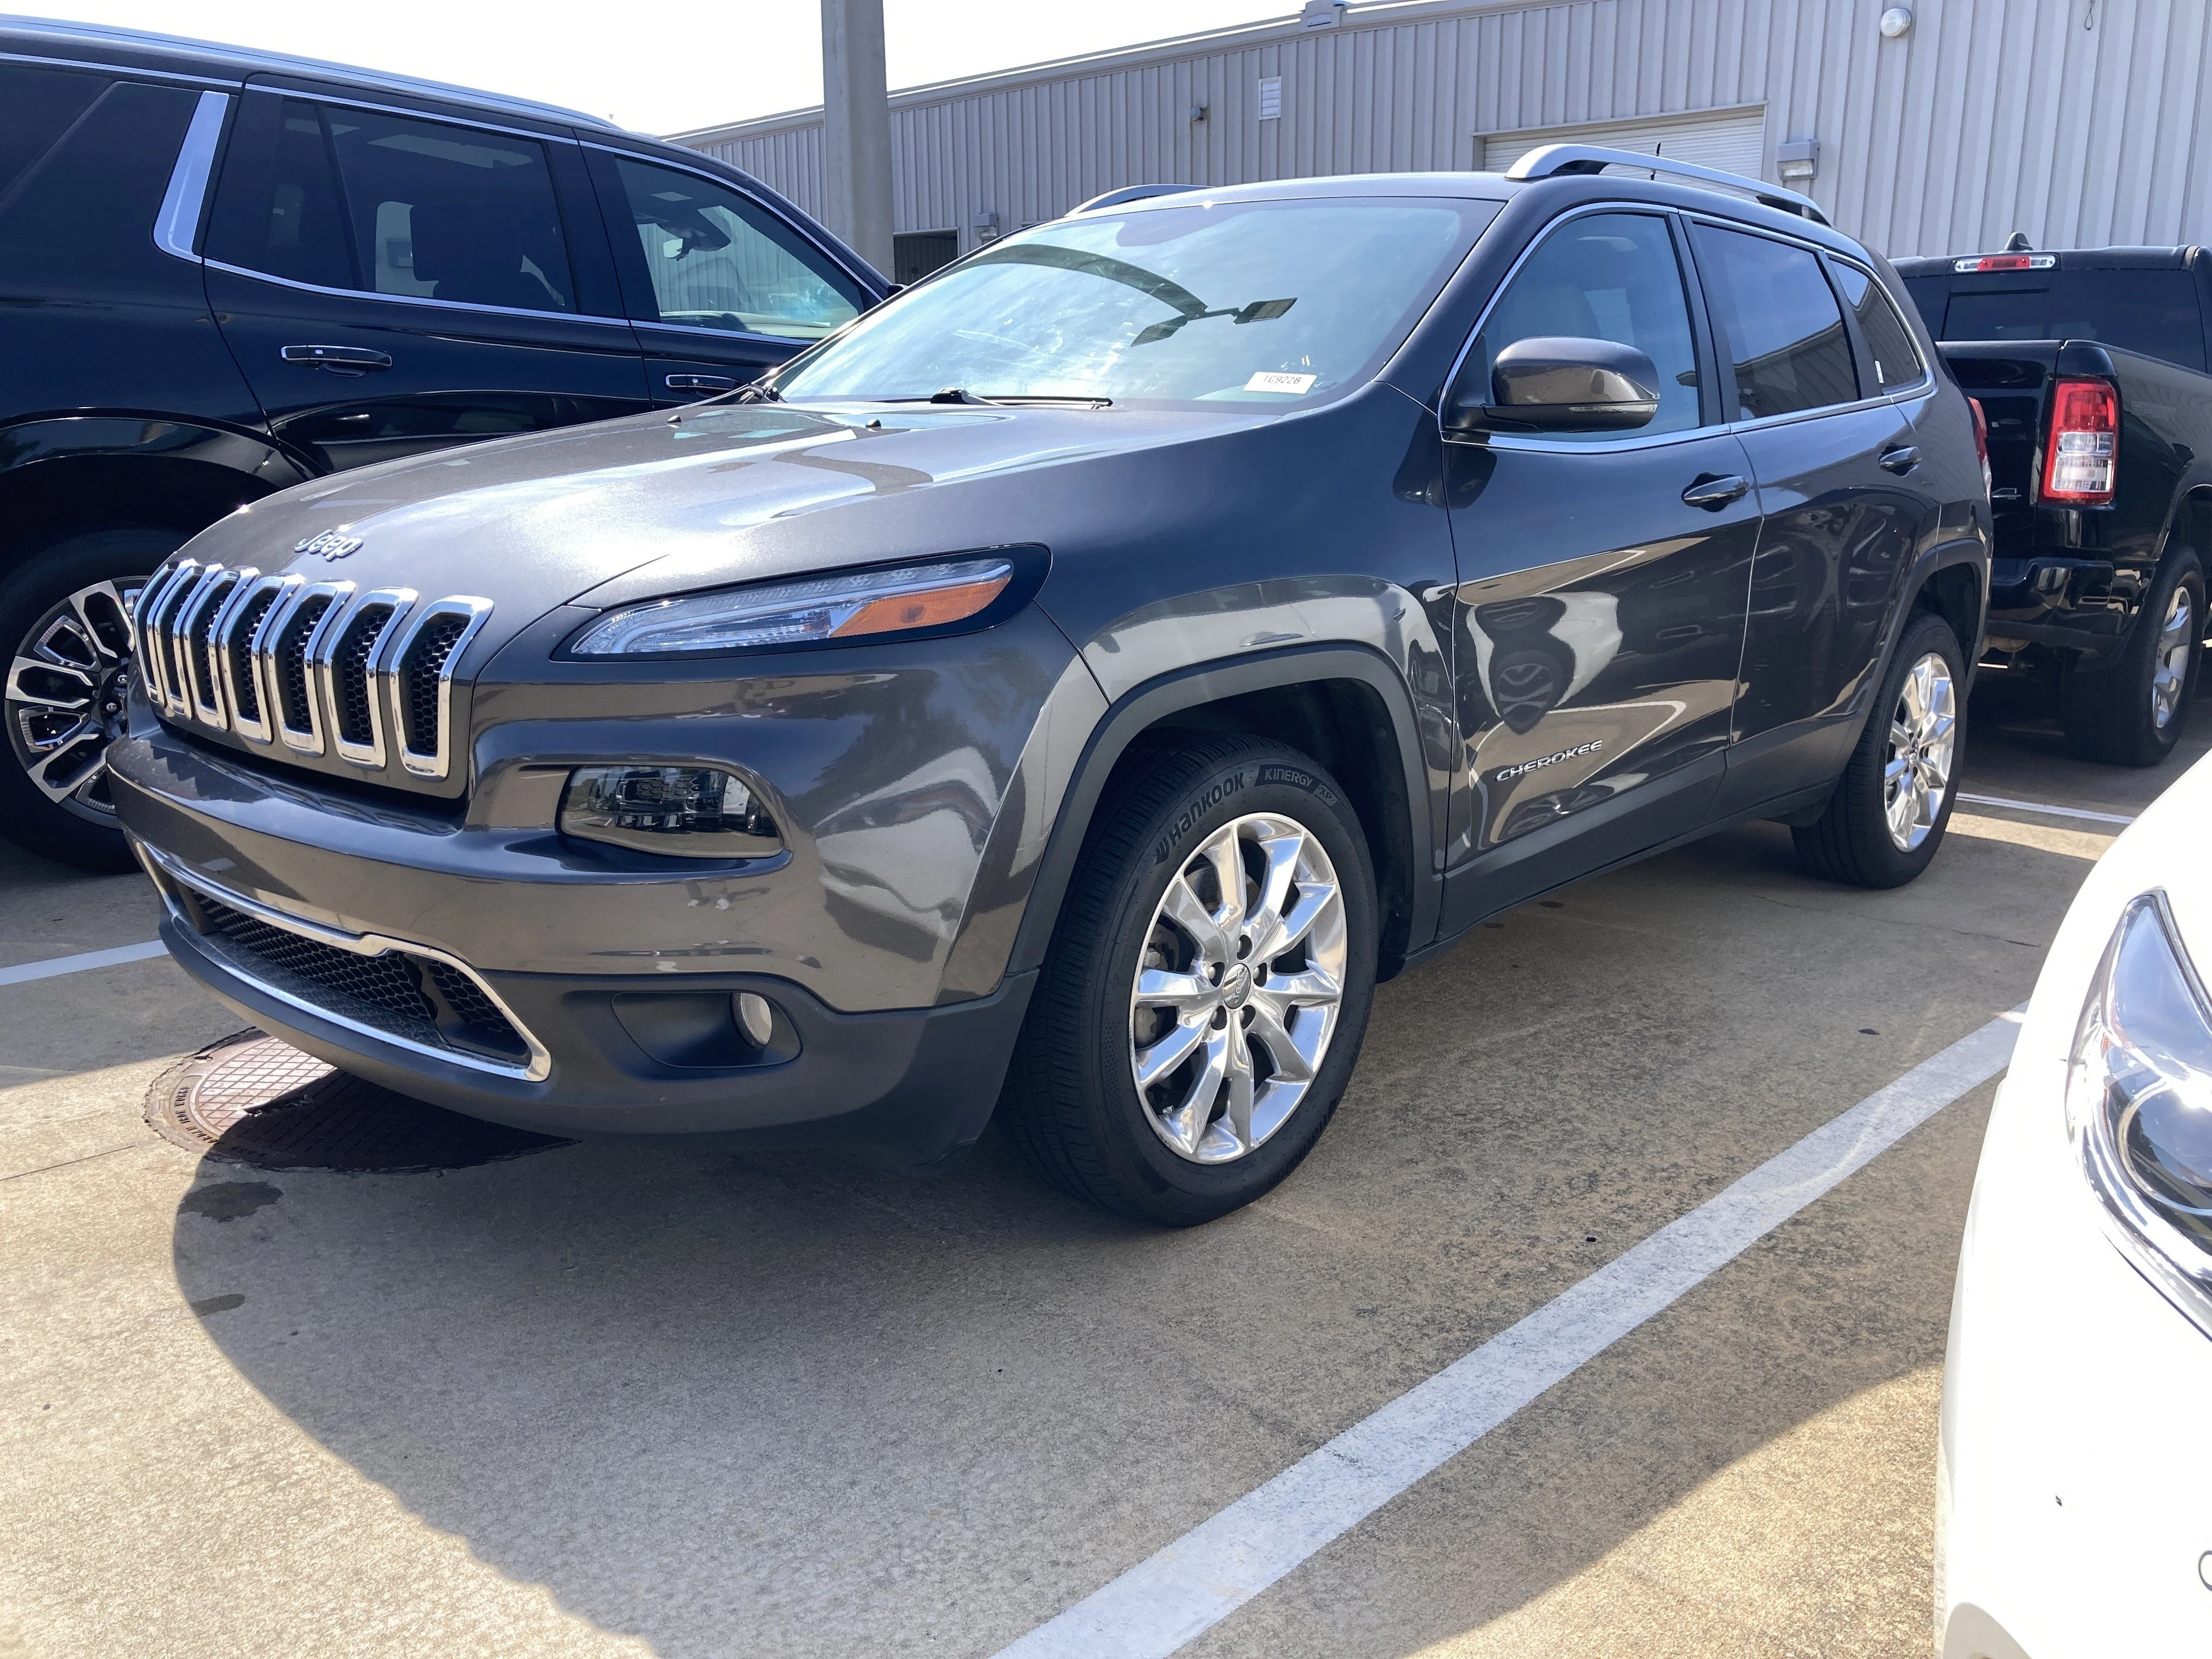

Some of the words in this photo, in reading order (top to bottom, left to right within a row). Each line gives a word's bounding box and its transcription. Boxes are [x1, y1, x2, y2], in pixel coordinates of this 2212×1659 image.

[294, 529, 364, 562] Jeep
[1494, 739, 1603, 782] CHEROKEE
[1264, 768, 1313, 787] KINERGY
